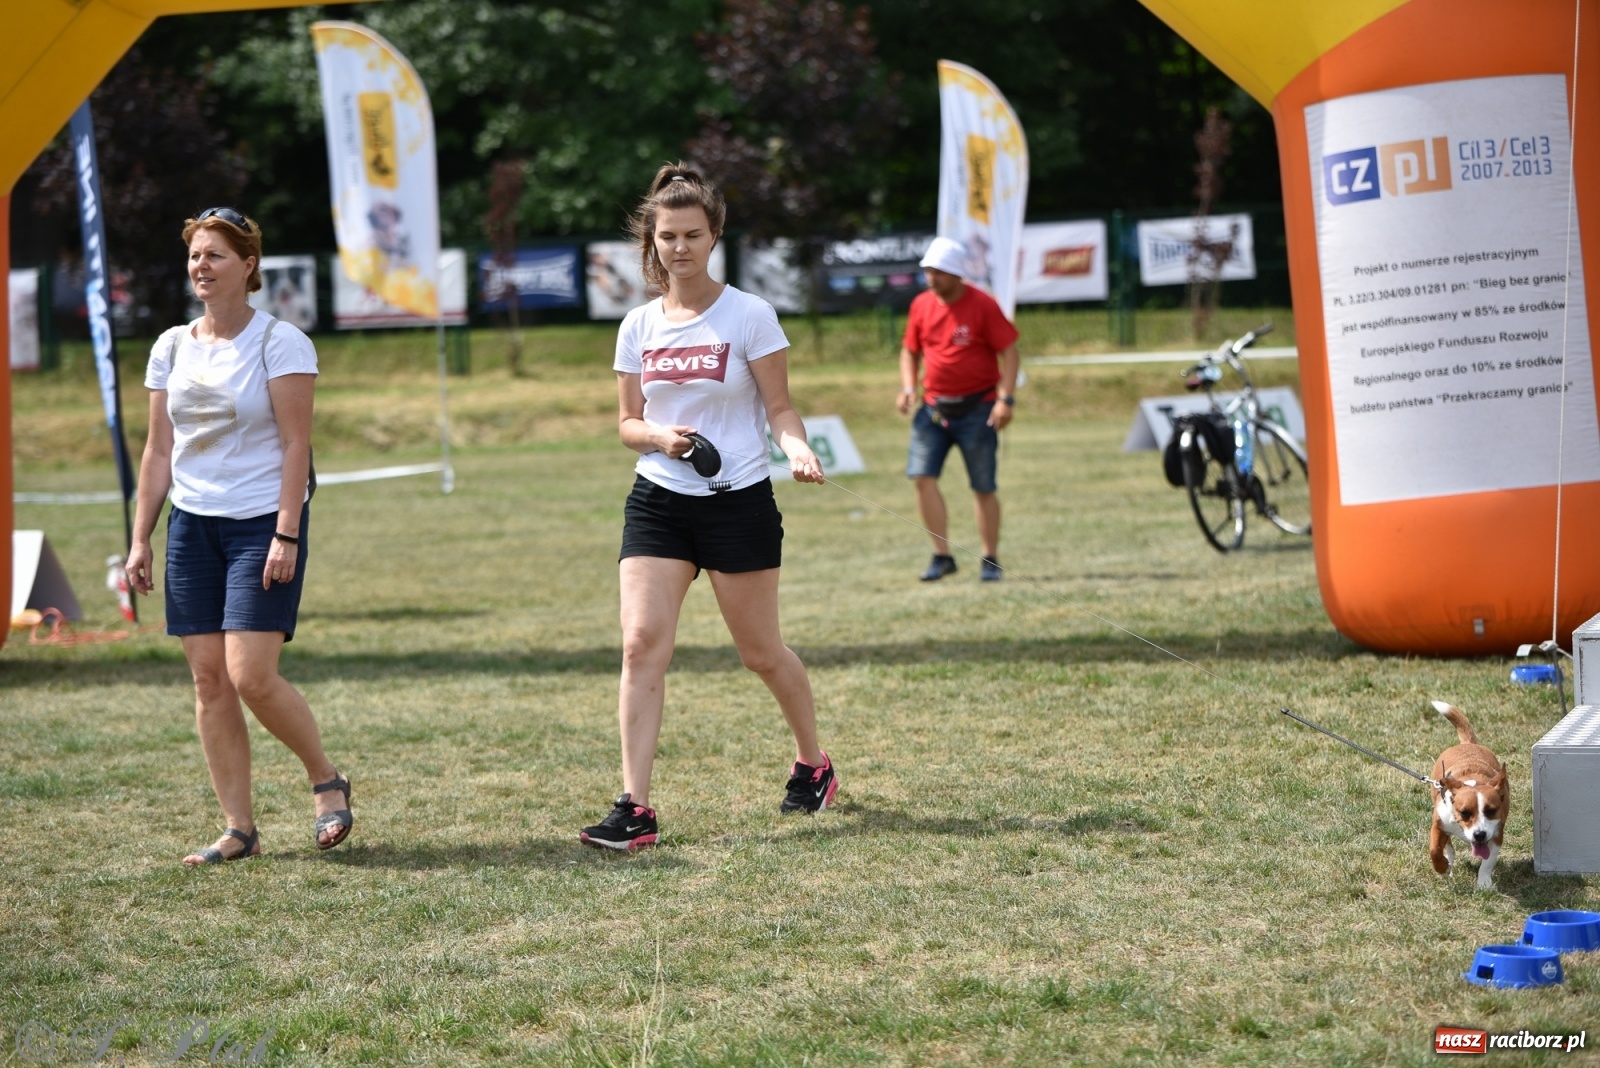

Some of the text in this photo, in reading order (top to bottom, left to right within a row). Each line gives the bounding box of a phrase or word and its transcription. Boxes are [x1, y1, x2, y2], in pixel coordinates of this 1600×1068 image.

[1354, 248, 1539, 276] Projekt o numerze rejestracyjnym
[1451, 281, 1470, 293] pn:
[1509, 275, 1530, 286] bez
[1342, 300, 1566, 335] jest współfinansowany w 85% ze środków
[1360, 328, 1548, 358] Europejskiego Funduszu Rozwoju
[1353, 355, 1564, 387] Regionalnego oraz do 10% ze środków
[1350, 402, 1386, 414] budżetu
[1388, 396, 1433, 411] państwa
